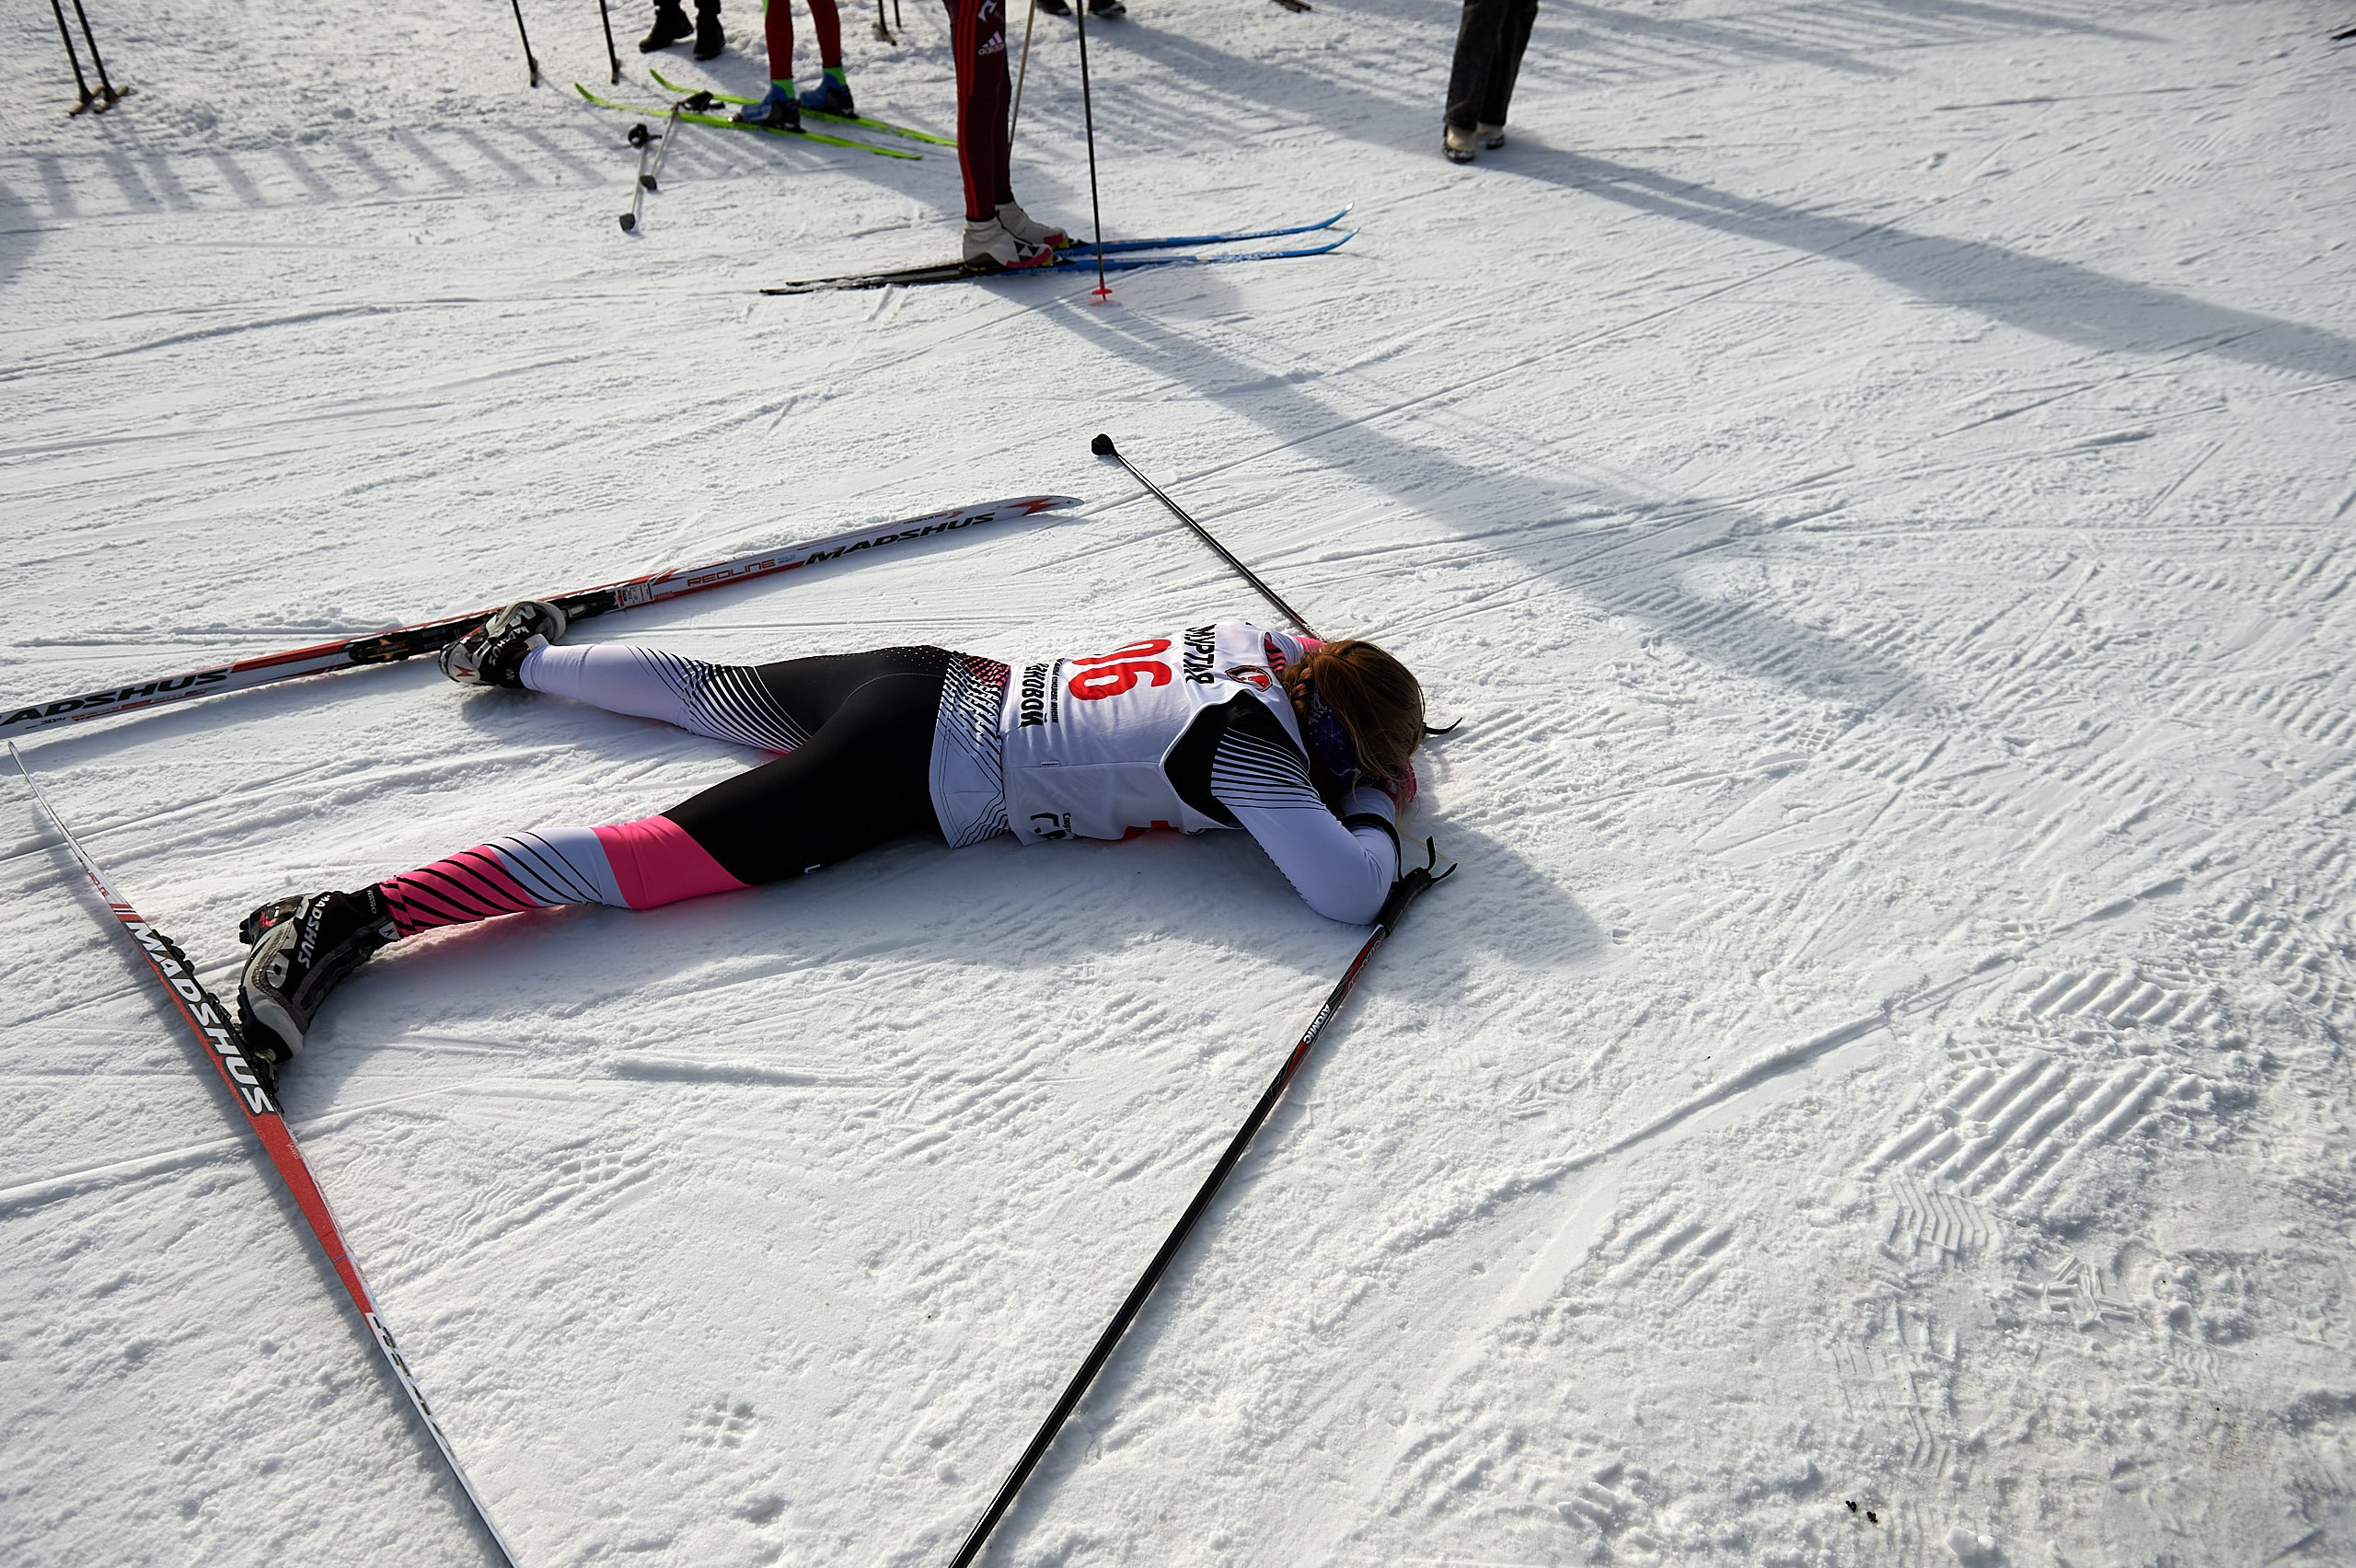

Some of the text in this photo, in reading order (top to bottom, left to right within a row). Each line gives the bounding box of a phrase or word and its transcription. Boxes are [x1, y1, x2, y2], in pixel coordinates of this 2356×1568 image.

[803, 512, 996, 566] MADSHUS
[687, 559, 776, 587] REDLINE
[0, 668, 228, 726] ADSHUS
[125, 921, 274, 1115] MADSHUS
[1303, 1003, 1331, 1044] ATOMIC
